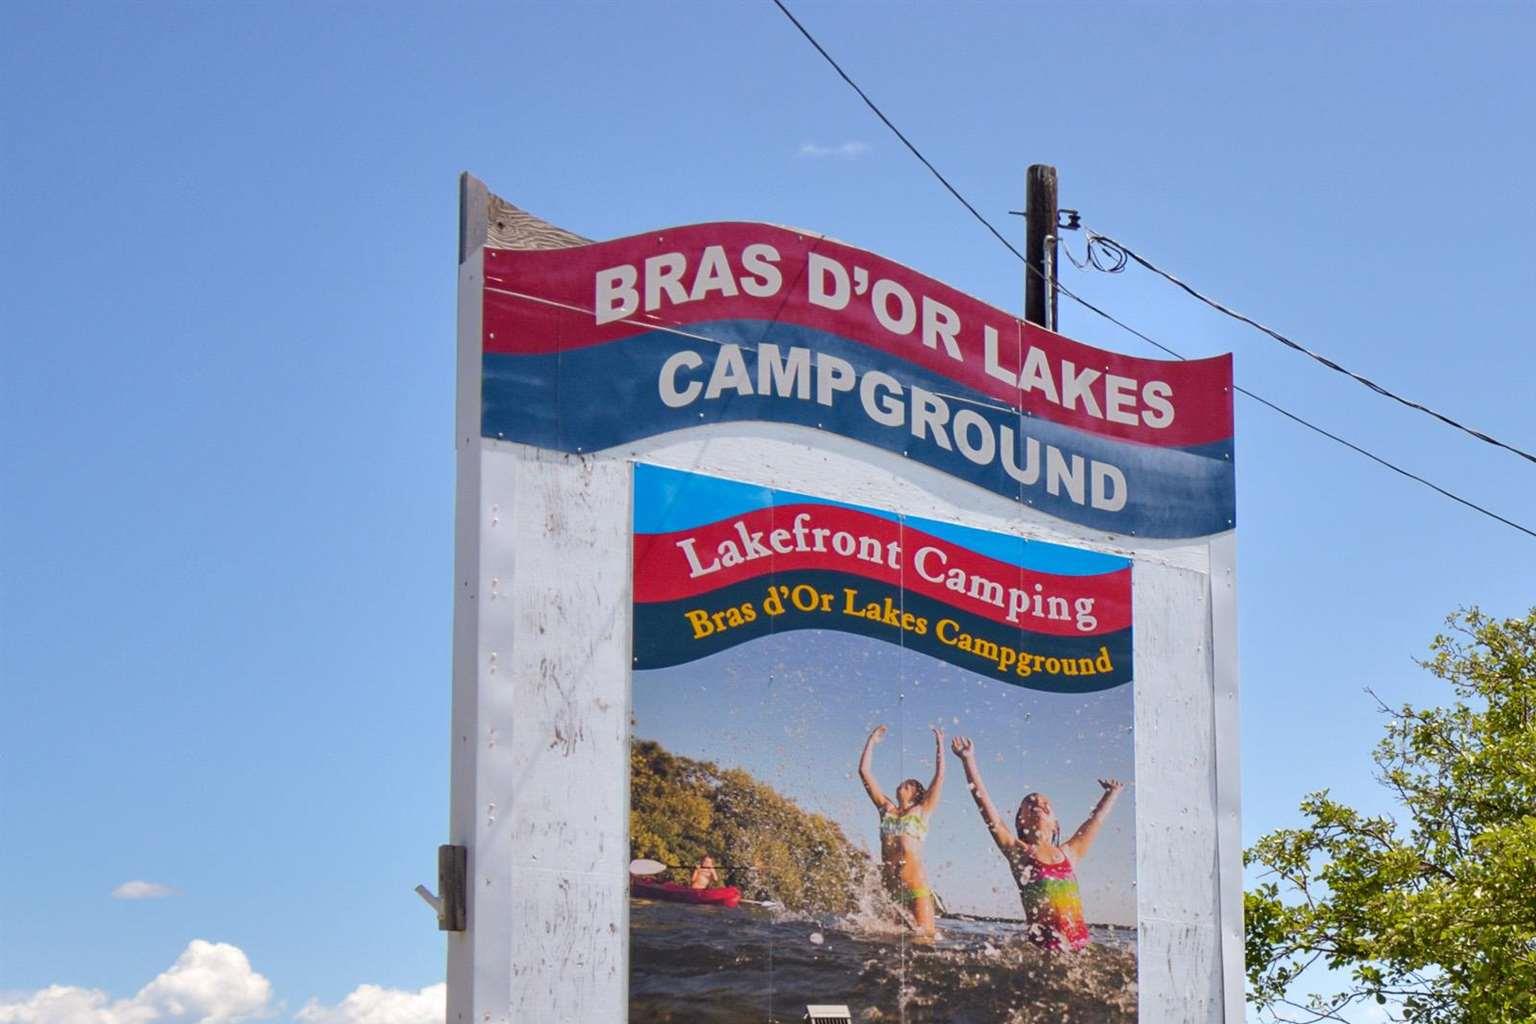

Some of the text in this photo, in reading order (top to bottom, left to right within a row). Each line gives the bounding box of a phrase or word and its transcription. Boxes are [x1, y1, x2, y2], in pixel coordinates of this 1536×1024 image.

[595, 243, 783, 325] BRAS
[984, 325, 1175, 429] LAKES
[657, 345, 1129, 513] CAMPGROUND
[676, 513, 1097, 632] Lakefront Camping
[685, 601, 757, 640] Bras
[843, 588, 928, 636] Lakes
[934, 619, 1114, 678] Campground
